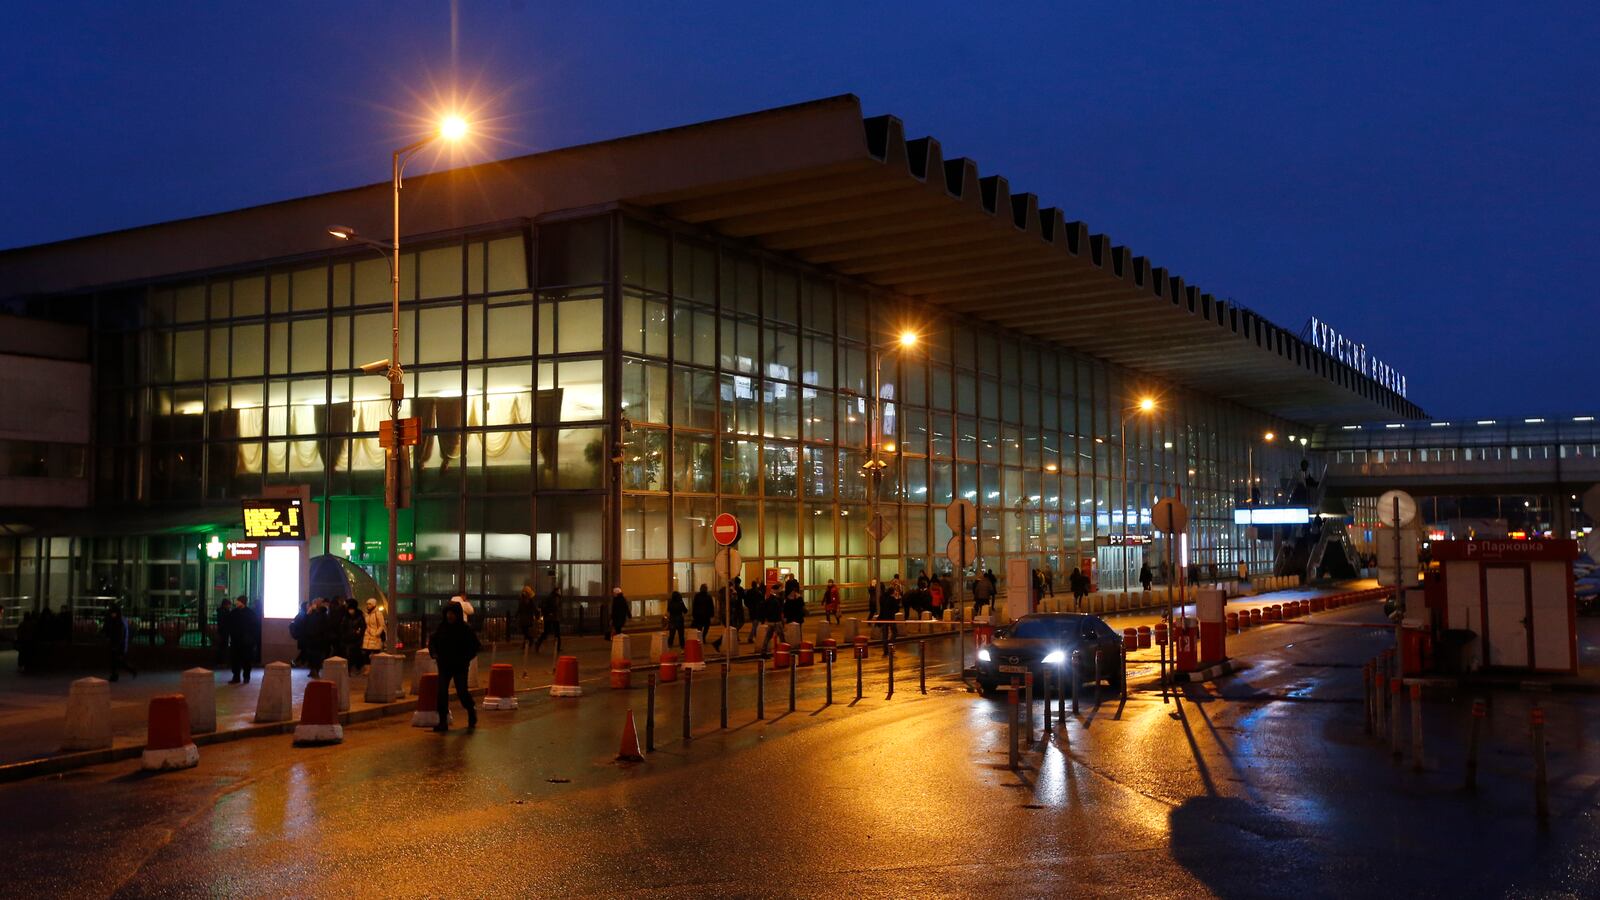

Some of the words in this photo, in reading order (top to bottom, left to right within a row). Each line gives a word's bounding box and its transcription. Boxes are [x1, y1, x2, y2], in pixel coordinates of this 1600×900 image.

[1311, 315, 1367, 376] КУРСКИЙ
[1371, 355, 1407, 398] ВОКЗАЛ
[1481, 541, 1544, 553] Парковка
